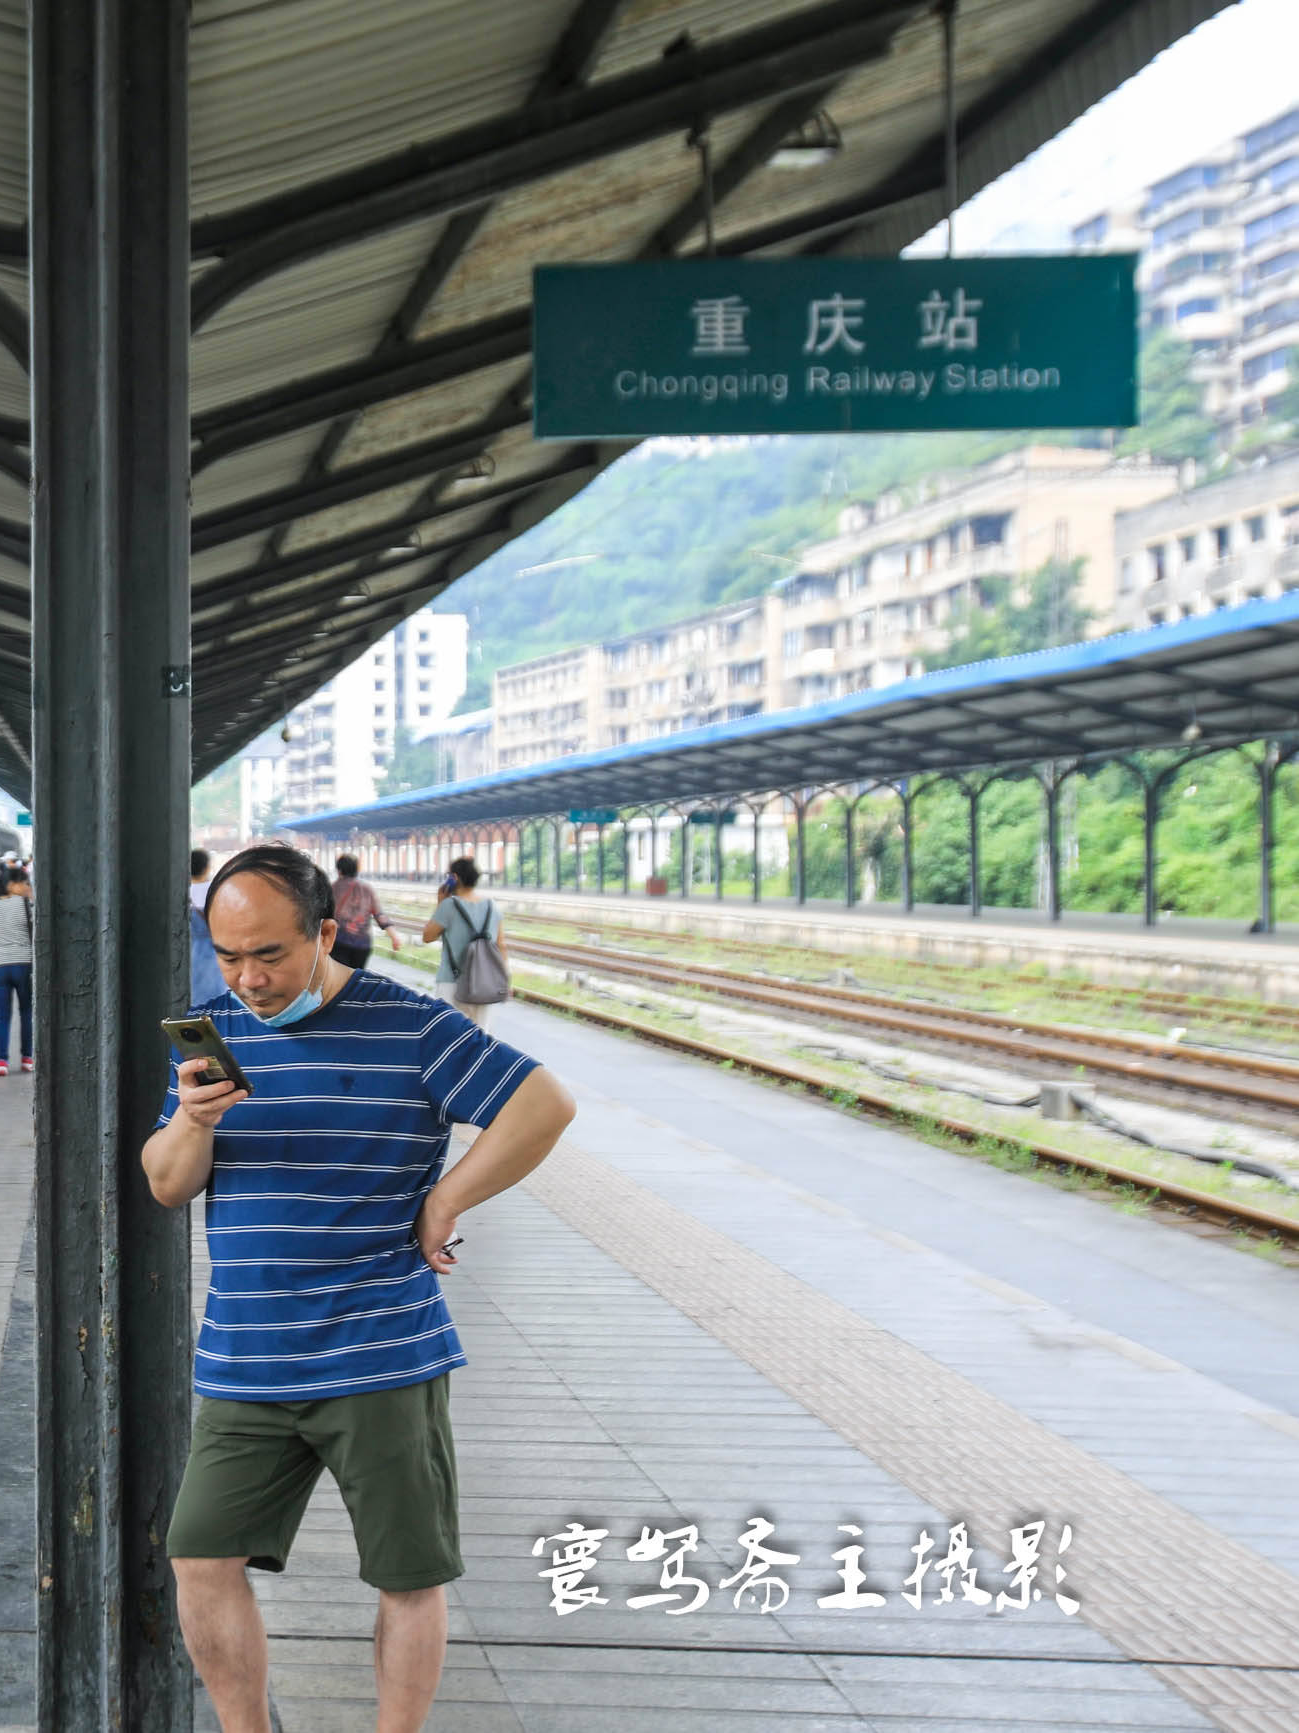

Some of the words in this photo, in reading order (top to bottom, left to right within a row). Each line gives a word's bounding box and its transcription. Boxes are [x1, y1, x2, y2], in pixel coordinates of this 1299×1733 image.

[690, 287, 983, 357] 重庆站
[614, 369, 789, 400] Chongqing
[806, 365, 935, 398] Railway
[945, 362, 1061, 391] Station
